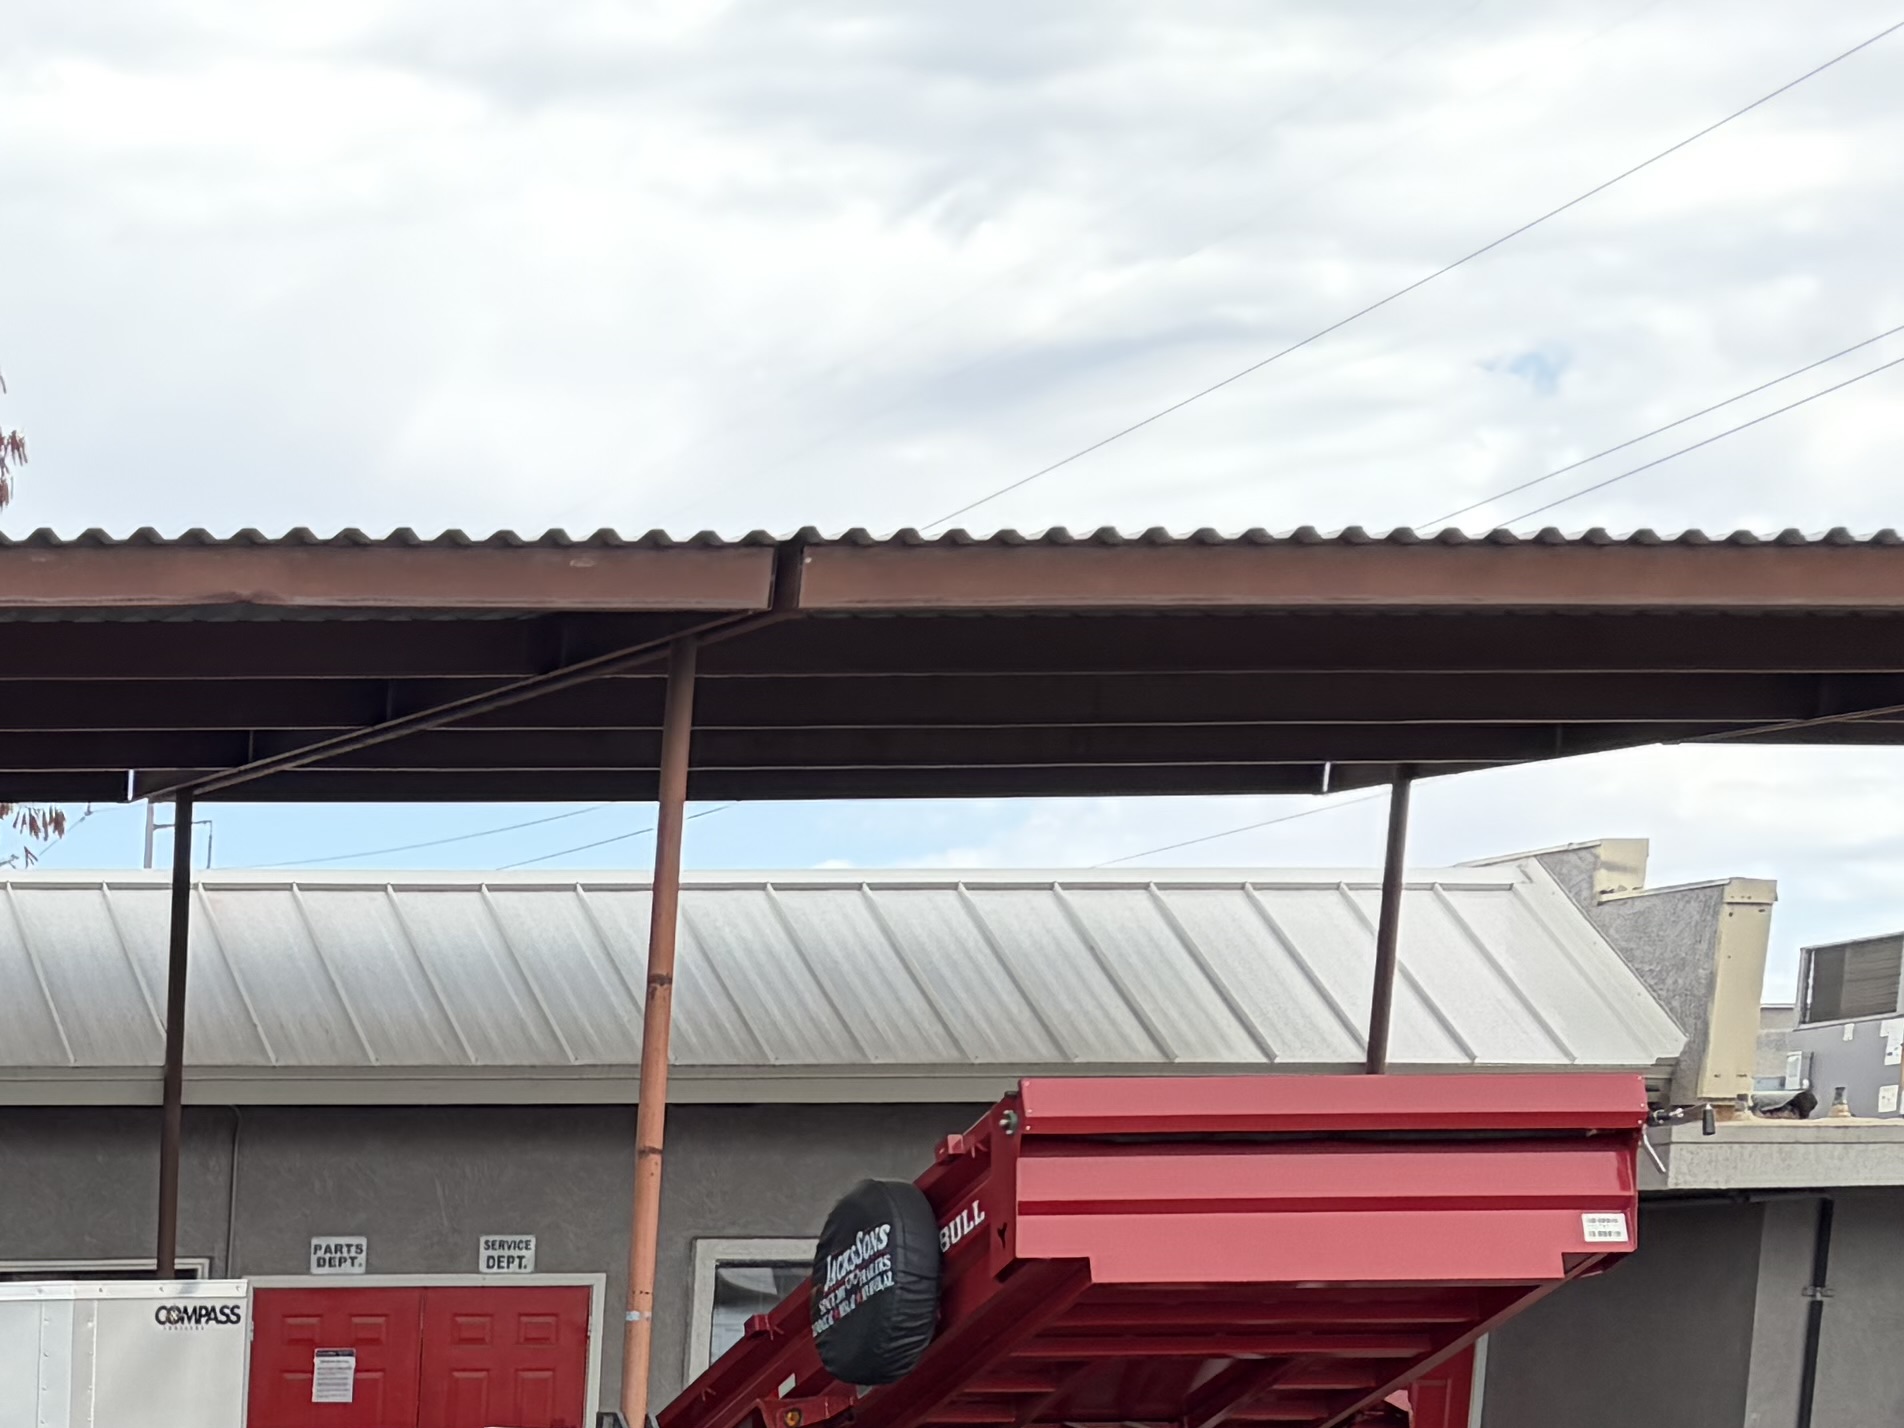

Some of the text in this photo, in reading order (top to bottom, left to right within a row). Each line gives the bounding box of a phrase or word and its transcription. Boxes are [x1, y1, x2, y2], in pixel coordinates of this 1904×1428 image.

[313, 1243, 364, 1255] PARTS
[483, 1239, 532, 1251] SERVICE
[316, 1256, 363, 1268] DEPT.
[486, 1255, 528, 1270] DEPT.
[155, 1304, 242, 1326] COMPASS
